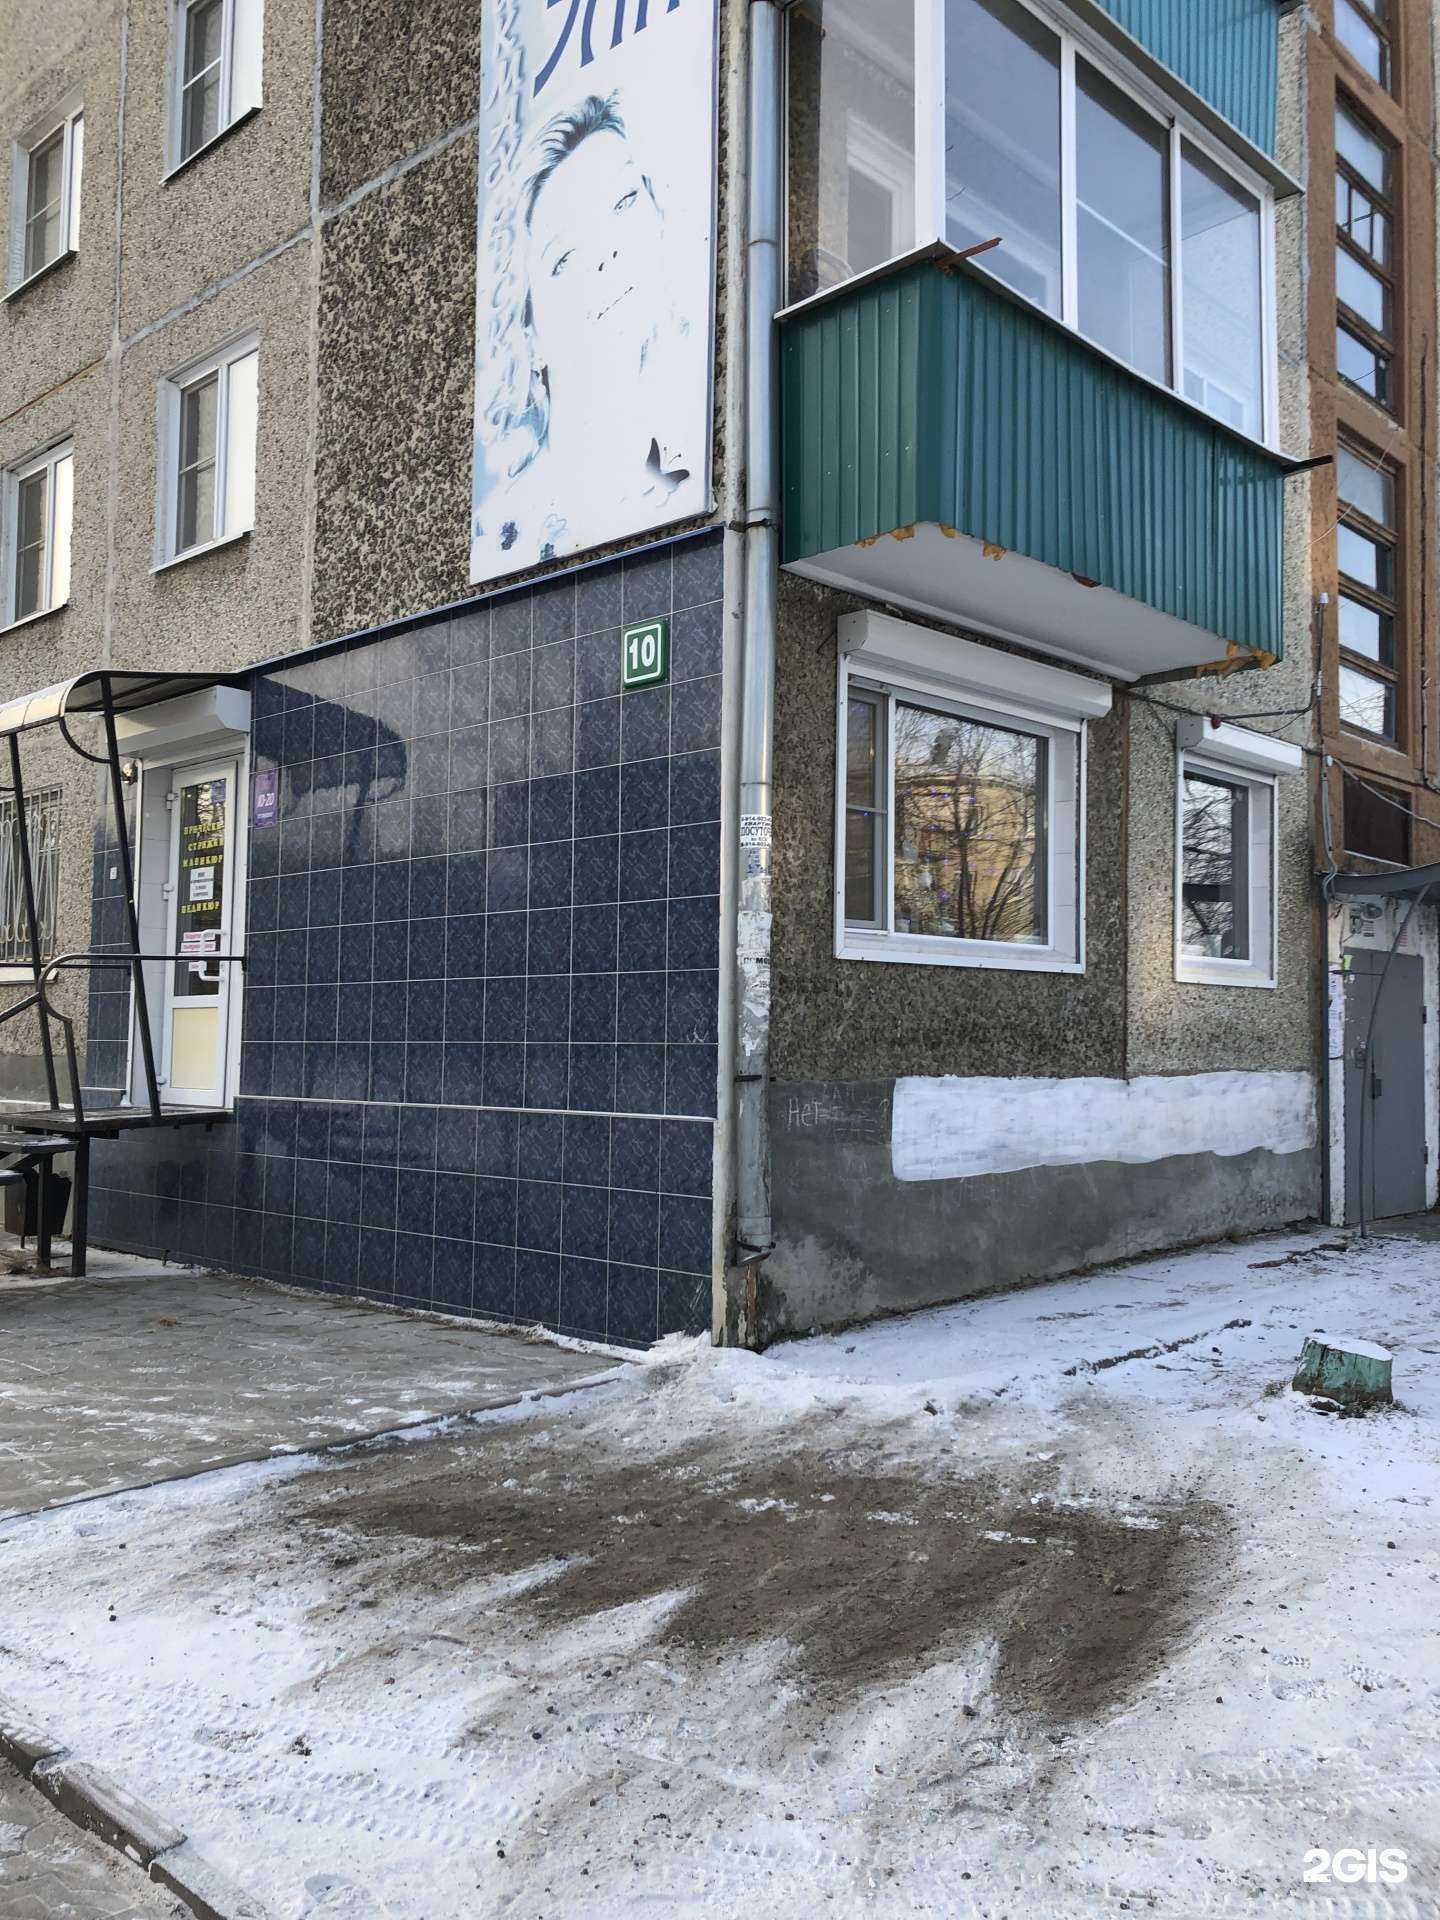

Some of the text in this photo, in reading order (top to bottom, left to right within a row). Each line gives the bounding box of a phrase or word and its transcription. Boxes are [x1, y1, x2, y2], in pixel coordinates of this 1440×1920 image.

[628, 634, 656, 670] 10
[182, 854, 224, 868] МАНИКЮР
[181, 901, 220, 914] ПЕДИКЮР
